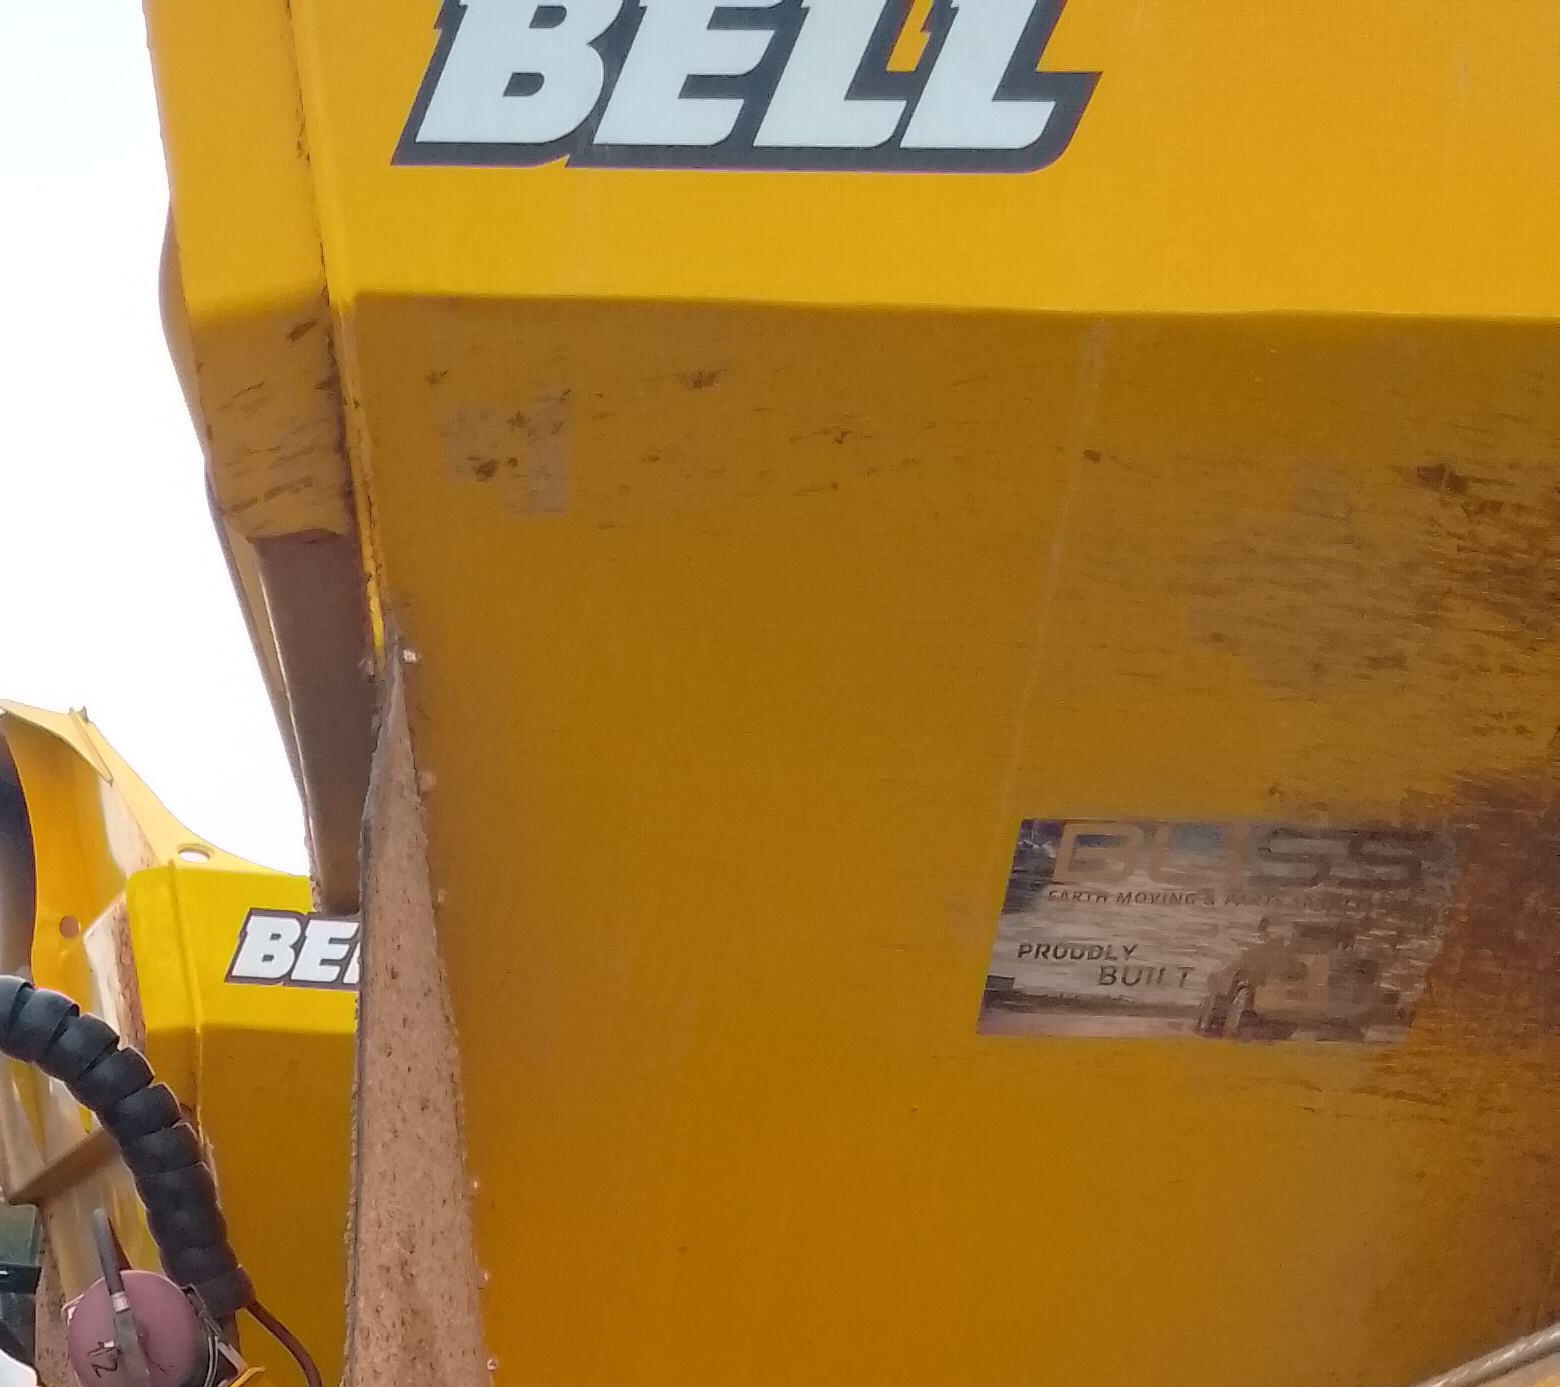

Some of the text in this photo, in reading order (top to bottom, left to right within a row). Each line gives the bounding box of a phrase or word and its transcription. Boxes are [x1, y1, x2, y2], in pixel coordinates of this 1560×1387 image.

[398, 0, 1086, 165] BELL
[1115, 891, 1197, 905] MOVING
[1017, 942, 1139, 961] PROUDLY
